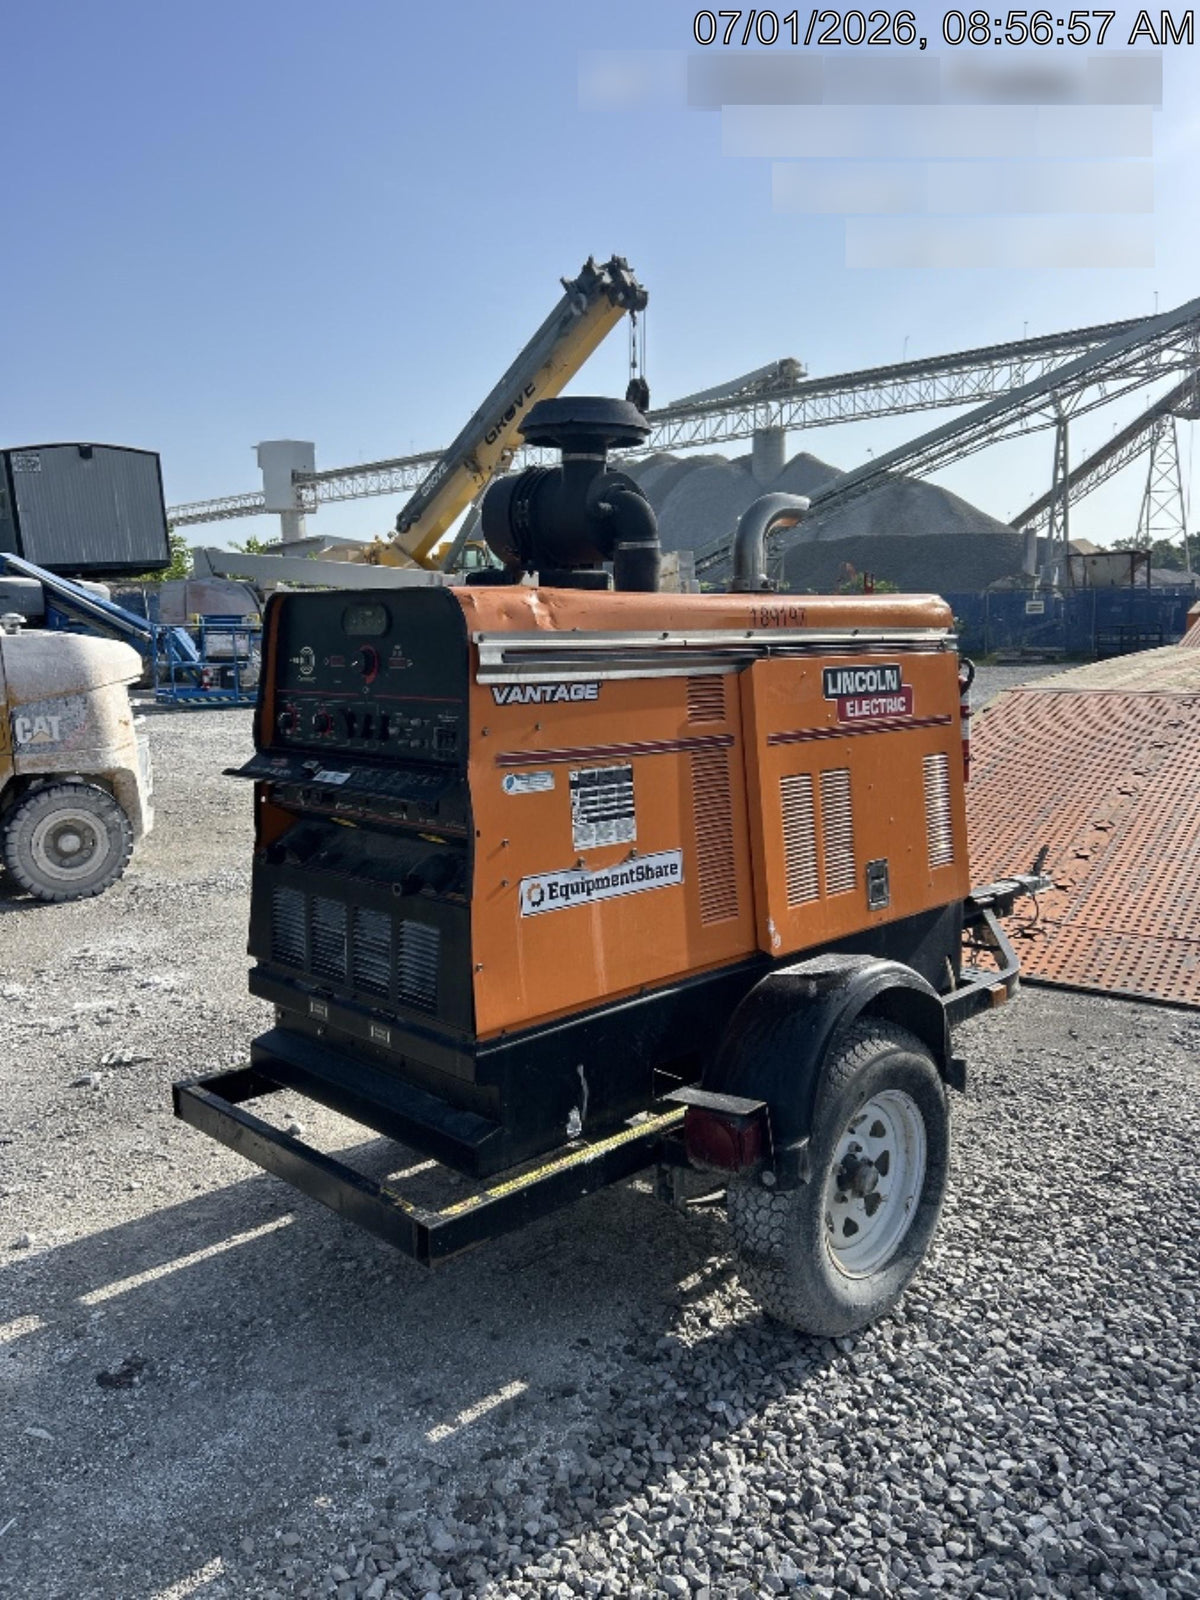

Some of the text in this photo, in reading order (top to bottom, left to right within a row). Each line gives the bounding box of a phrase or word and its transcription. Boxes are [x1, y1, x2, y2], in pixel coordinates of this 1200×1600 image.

[492, 683, 600, 704] VANTAGE
[827, 669, 898, 695] LINCOLN
[845, 696, 907, 717] ELECTRIC
[15, 715, 62, 744] CAT
[547, 863, 679, 900] EquipmentShare
